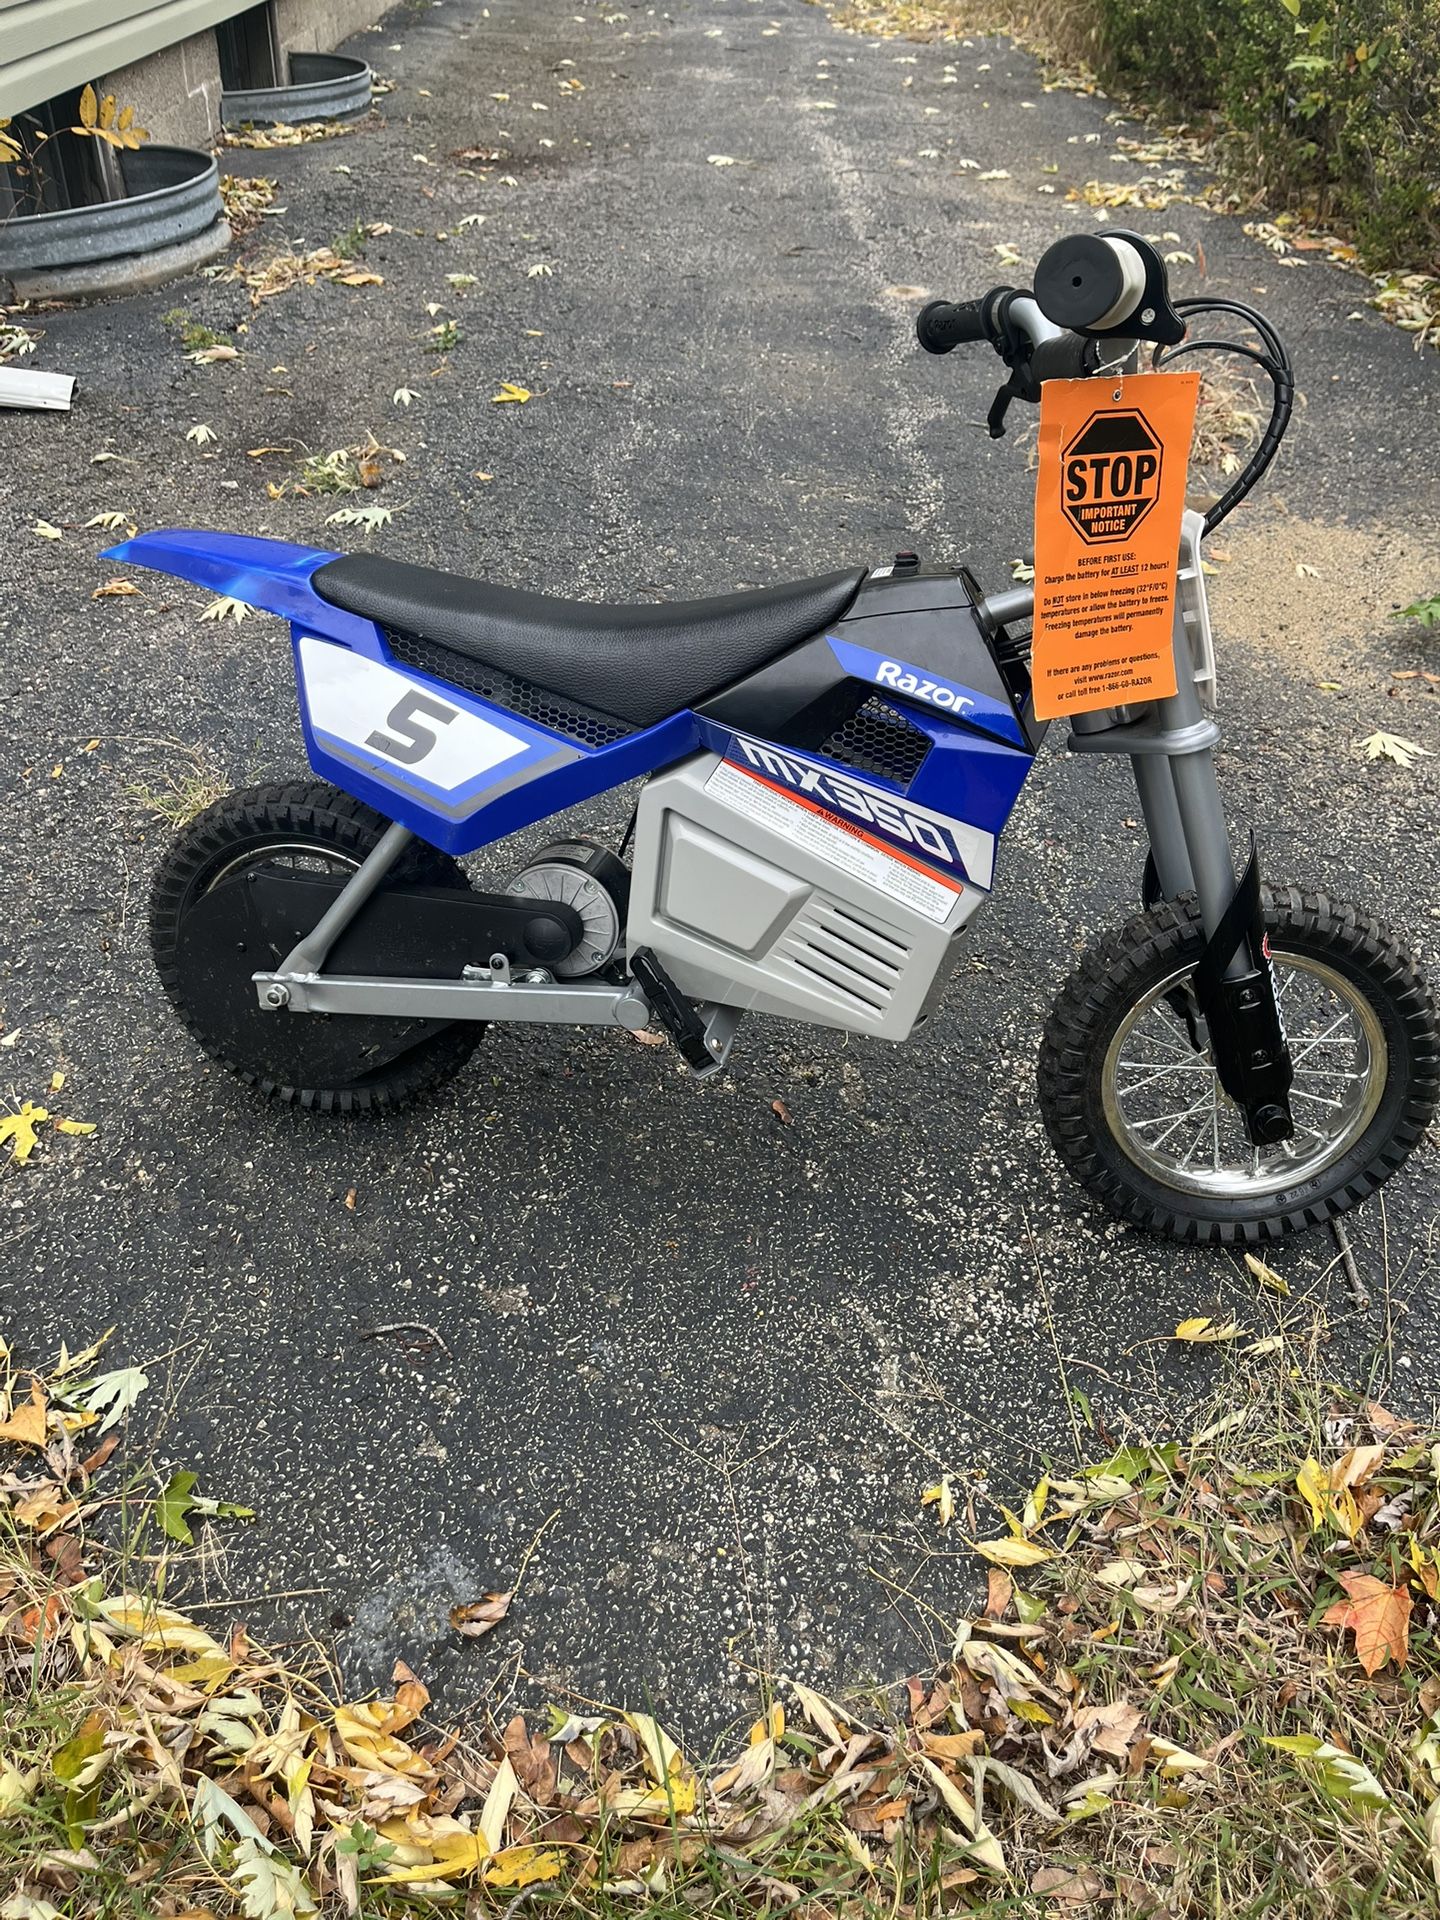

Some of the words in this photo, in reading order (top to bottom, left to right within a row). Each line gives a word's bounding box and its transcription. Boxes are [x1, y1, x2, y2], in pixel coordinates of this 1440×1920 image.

[1067, 454, 1157, 502] STOP
[1081, 504, 1137, 521] IMPORTANT
[1091, 519, 1125, 534] NOTICE
[1078, 556, 1102, 566] BEFORE
[1104, 554, 1121, 564] FIRST
[1122, 553, 1136, 562] USE:
[1045, 575, 1064, 585] Charge
[1066, 573, 1075, 581] the
[1077, 570, 1099, 580] battery
[1101, 568, 1110, 577] for
[1111, 567, 1118, 575] AT
[1120, 565, 1138, 574] LEAST
[1150, 561, 1169, 570] hours!
[1041, 606, 1080, 620] temperatures
[1089, 602, 1106, 611] allow
[1107, 601, 1117, 609] the
[1118, 598, 1140, 609] battery
[1149, 595, 1169, 603] freeze.
[1044, 598, 1051, 606] Do
[1052, 596, 1064, 605] NOT
[1066, 594, 1081, 602] store
[1090, 589, 1108, 599] below
[1110, 587, 1135, 597] freezing
[1045, 620, 1071, 630] Freezing
[1072, 615, 1112, 627] temperatures
[1126, 608, 1164, 620] permanently
[1075, 629, 1098, 639] damage
[1111, 624, 1133, 634] battery.
[1047, 669, 1052, 677] If
[1053, 667, 1068, 676] there
[1070, 665, 1080, 673] are
[1082, 664, 1092, 673] any
[1094, 659, 1120, 670] problems
[1129, 652, 1160, 664] questions,
[875, 660, 975, 714] Razor
[1065, 690, 1076, 699] call
[1077, 688, 1087, 696] toll
[1089, 686, 1100, 694] free
[1102, 676, 1152, 692] 1-866-GO-RAZOR
[1074, 677, 1087, 685] visit
[1088, 668, 1133, 682] www.razor.com
[736, 737, 955, 864] MX350
[824, 809, 864, 839] WARNING
